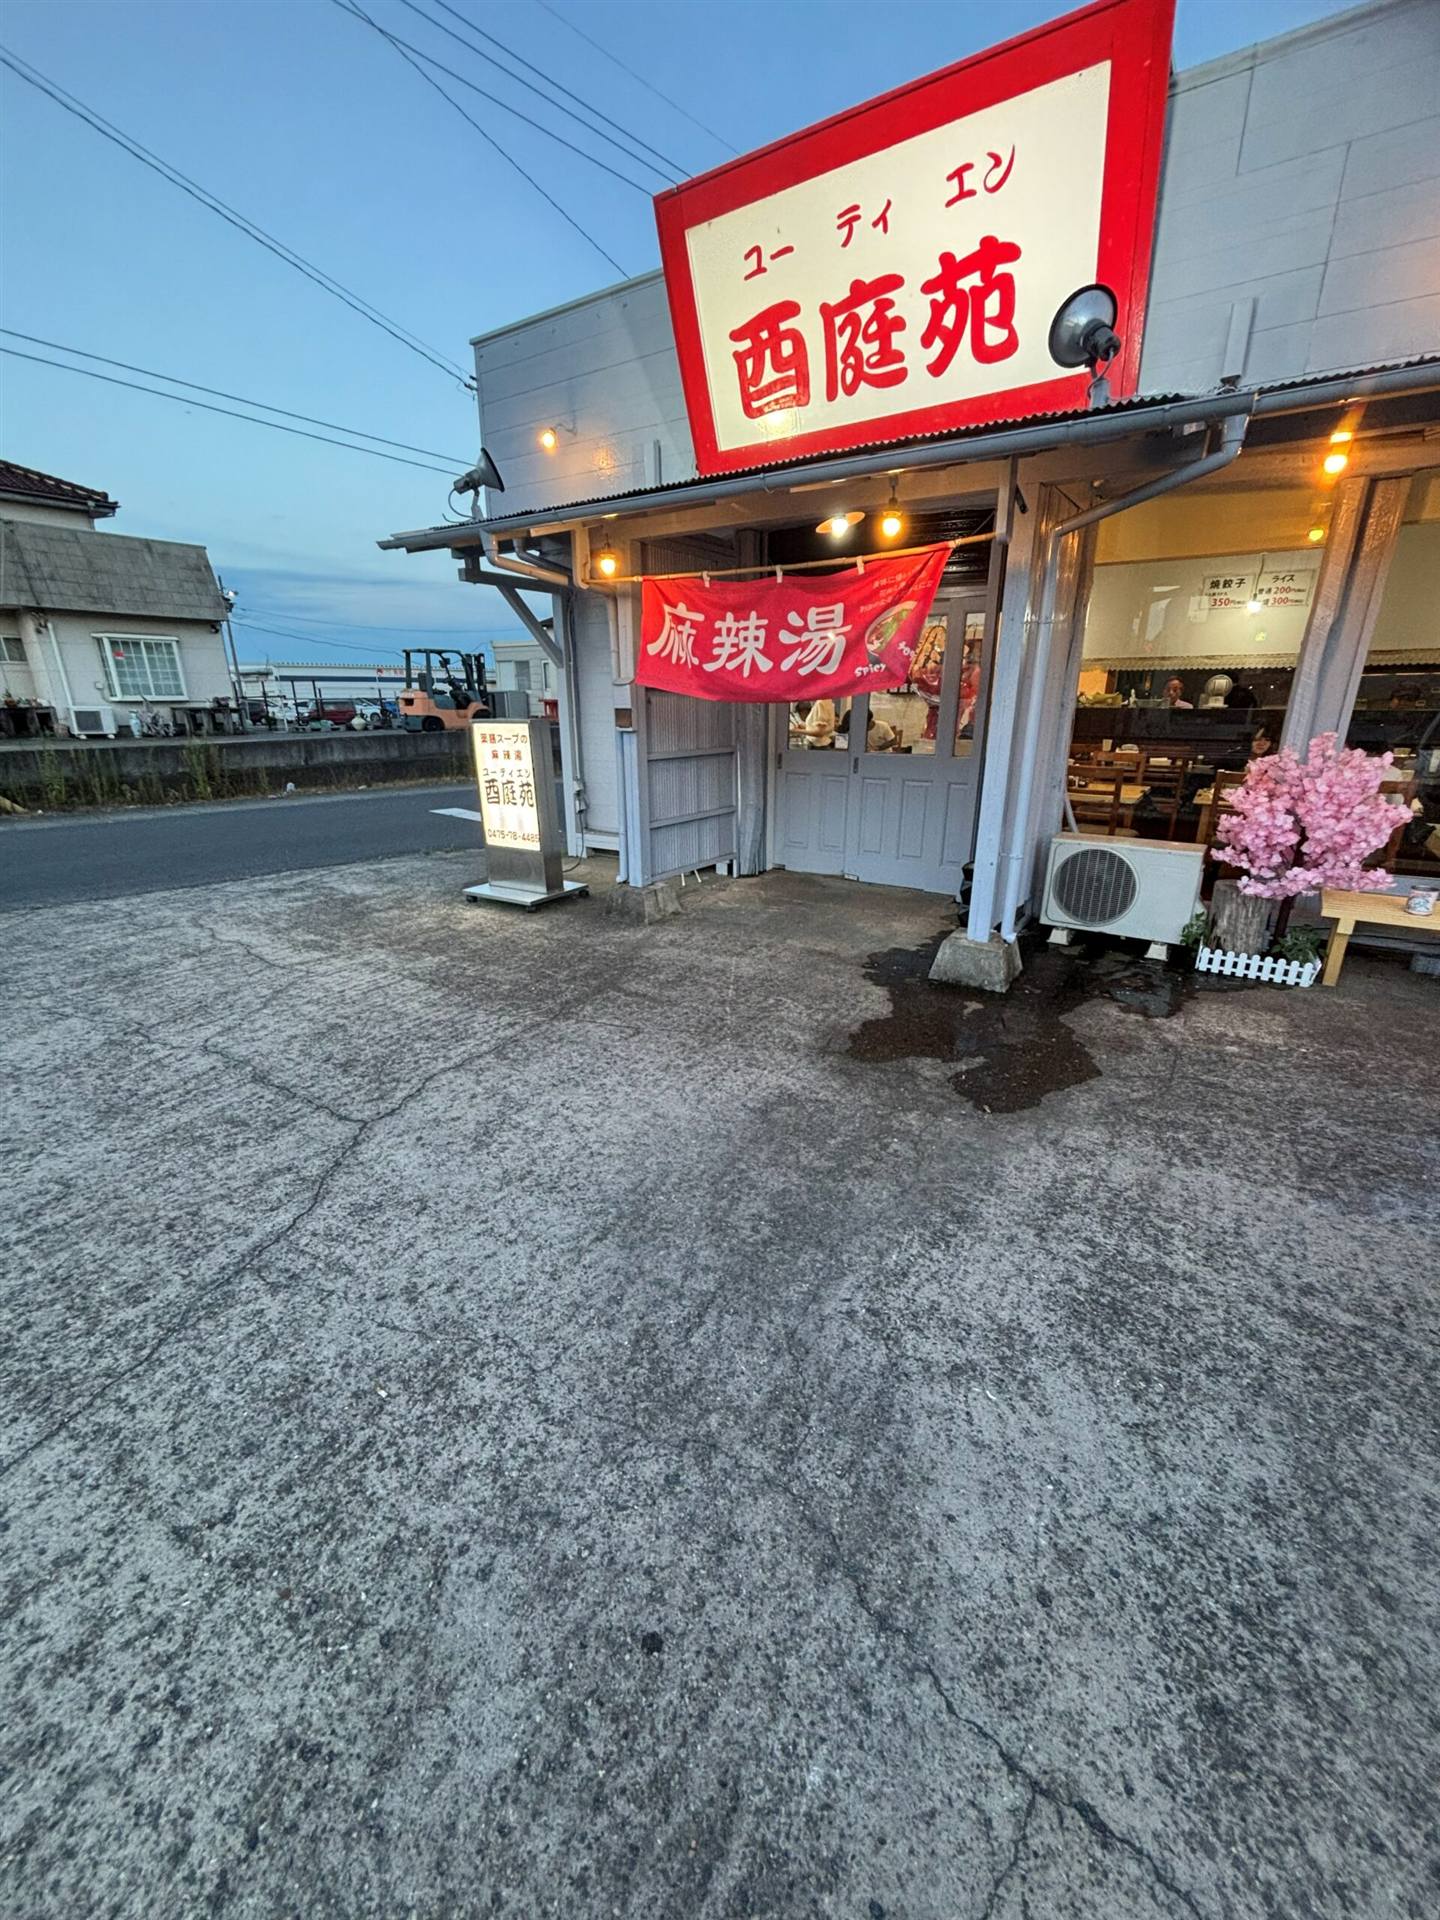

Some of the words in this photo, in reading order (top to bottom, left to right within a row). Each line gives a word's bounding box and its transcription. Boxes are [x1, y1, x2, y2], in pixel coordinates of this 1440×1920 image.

[1272, 574, 1296, 583] ライス
[646, 602, 852, 678] 麻辣湯
[854, 663, 886, 677] Spicy
